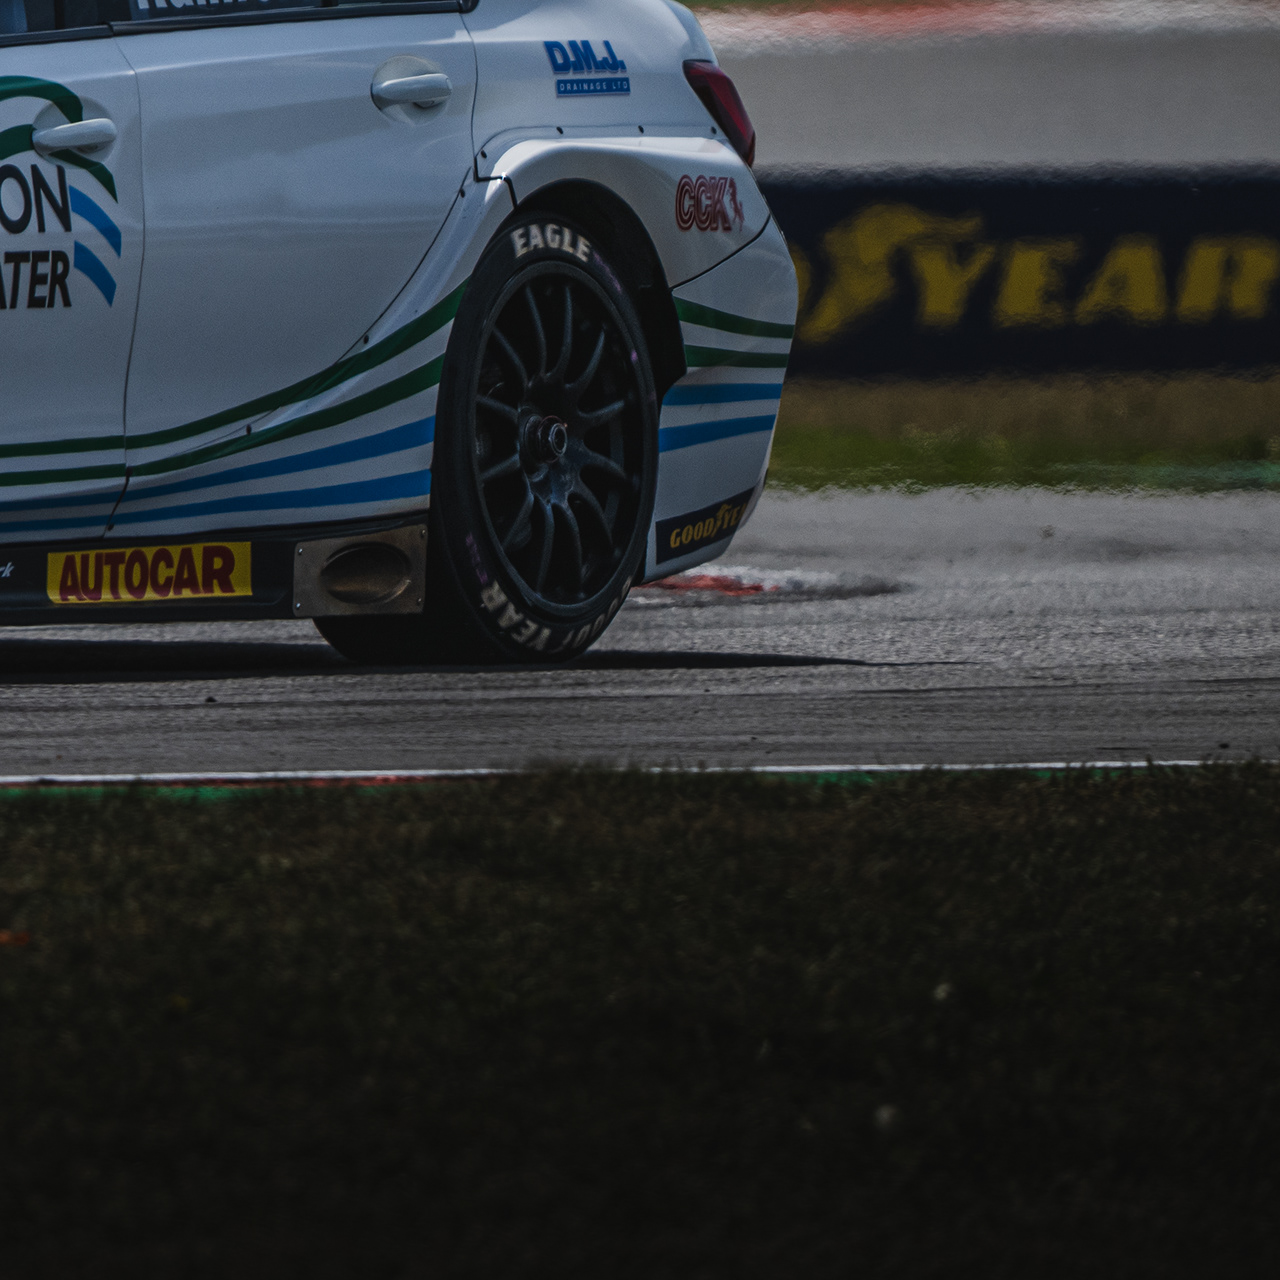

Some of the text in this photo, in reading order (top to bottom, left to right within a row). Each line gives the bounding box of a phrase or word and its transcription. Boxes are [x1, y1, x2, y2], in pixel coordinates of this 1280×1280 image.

[543, 40, 627, 73] D.M.J.
[559, 81, 628, 91] DRAINAGE LTD
[675, 174, 732, 232] CCK
[510, 222, 592, 264] EAGLE
[58, 545, 236, 602] AUTOCAR
